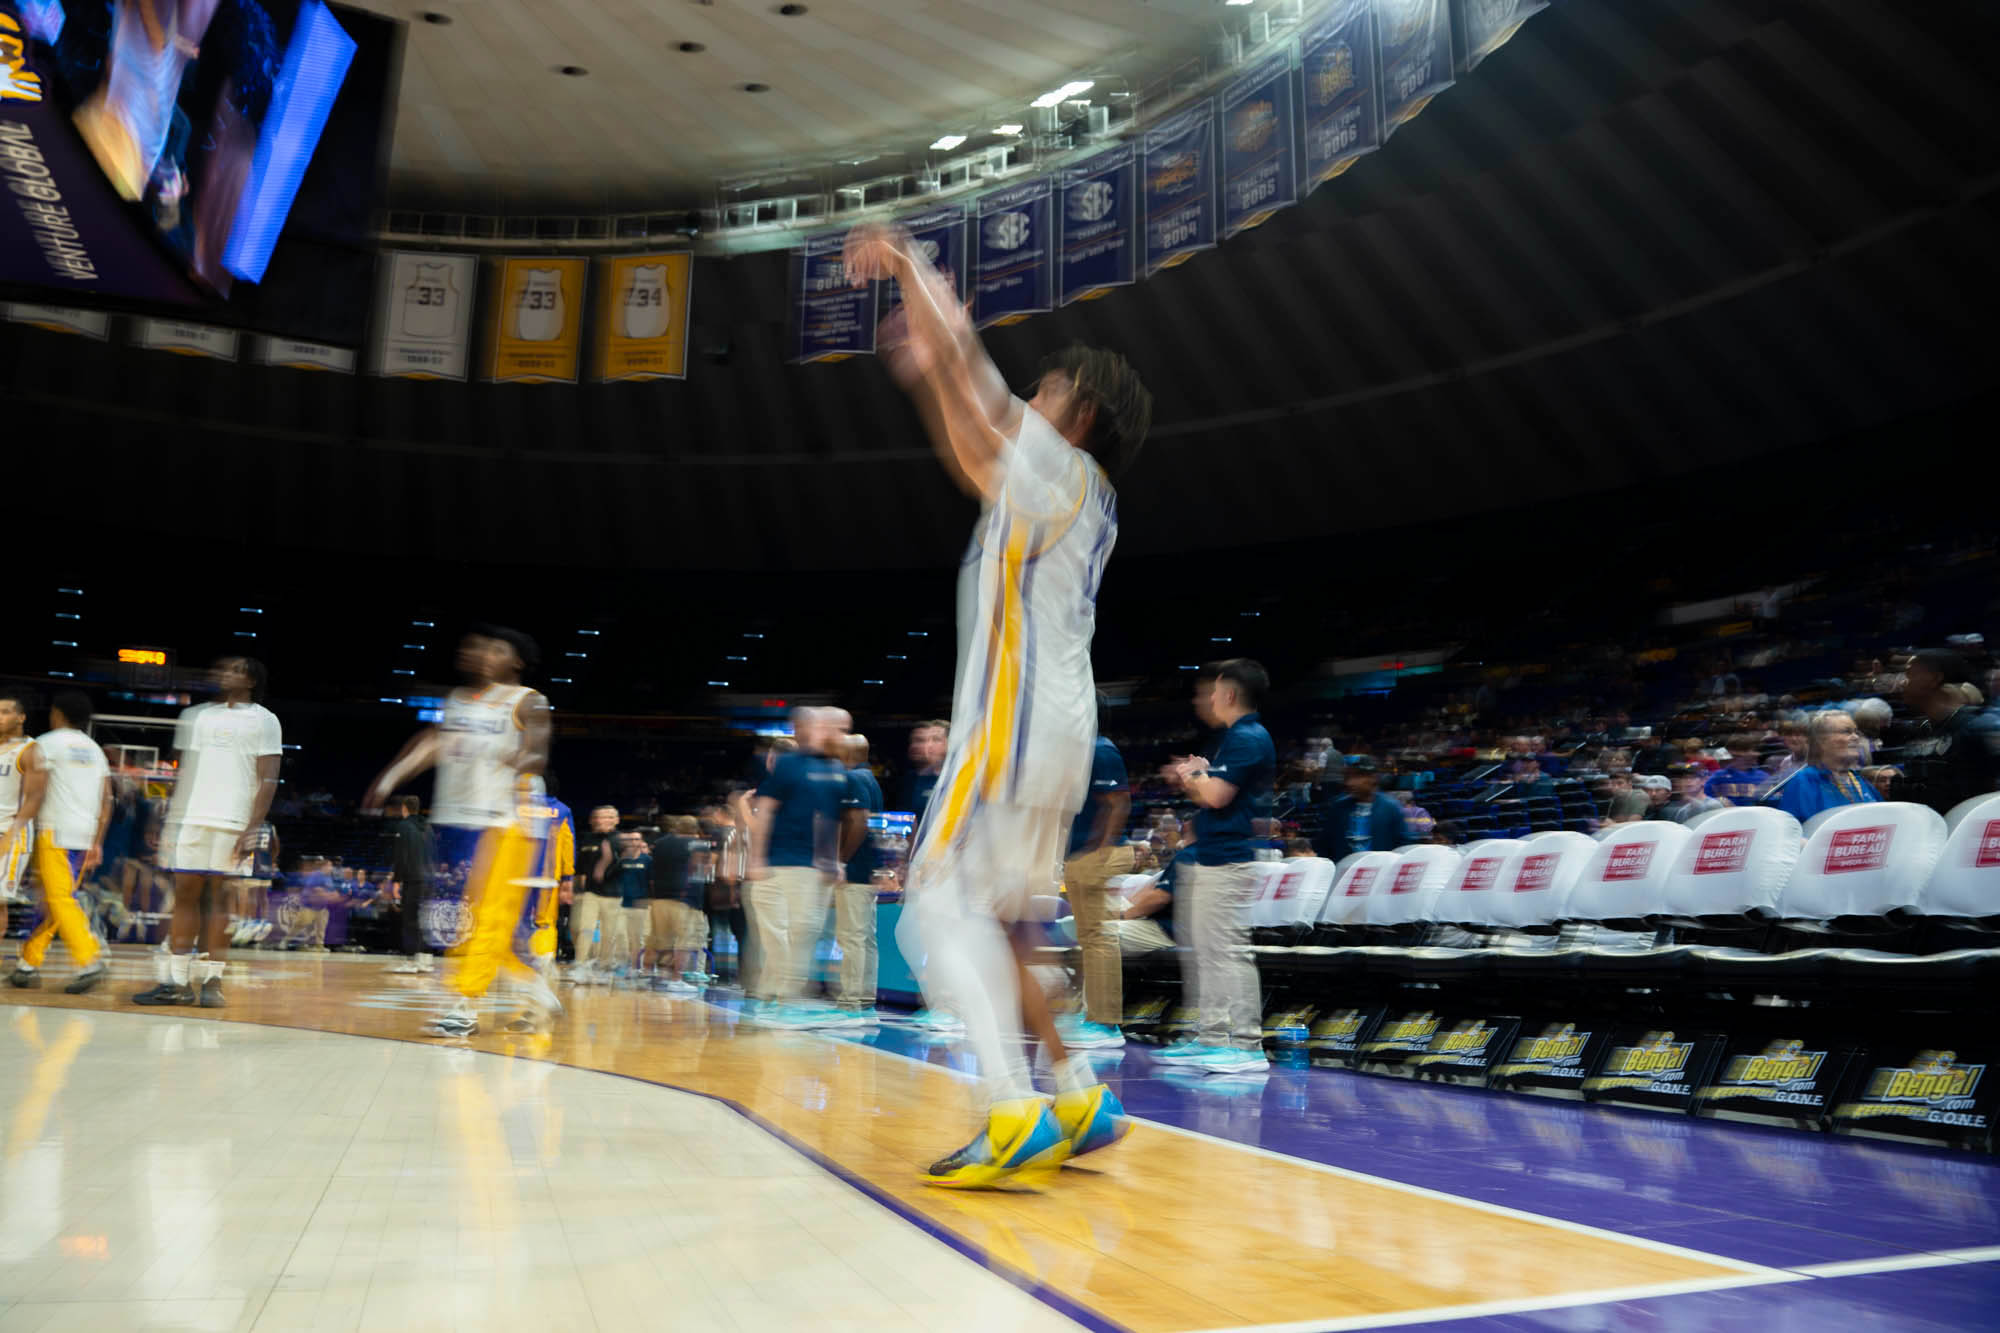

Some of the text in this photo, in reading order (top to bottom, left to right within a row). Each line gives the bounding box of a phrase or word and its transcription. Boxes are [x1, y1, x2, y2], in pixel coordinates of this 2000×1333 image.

[0, 121, 62, 202] GLOBAL
[1080, 181, 1114, 221] SEC
[32, 202, 98, 279] VENTURE
[997, 212, 1031, 249] SEC
[416, 286, 446, 308] 33
[529, 290, 556, 311] 33
[636, 287, 662, 307] 34
[1719, 837, 1748, 848] FARM
[1851, 831, 1888, 845] FARM
[1625, 847, 1652, 857] FARM
[1703, 846, 1746, 859] BUREAU
[1834, 843, 1885, 858] BUREAU
[1611, 856, 1650, 868] BUREAU
[1530, 1035, 1587, 1060] Bengal
[1624, 1045, 1689, 1073] Bengal
[1743, 1055, 1822, 1083] Bengal
[1887, 1067, 1979, 1099] Bengal
[1941, 1099, 1976, 1111] .com
